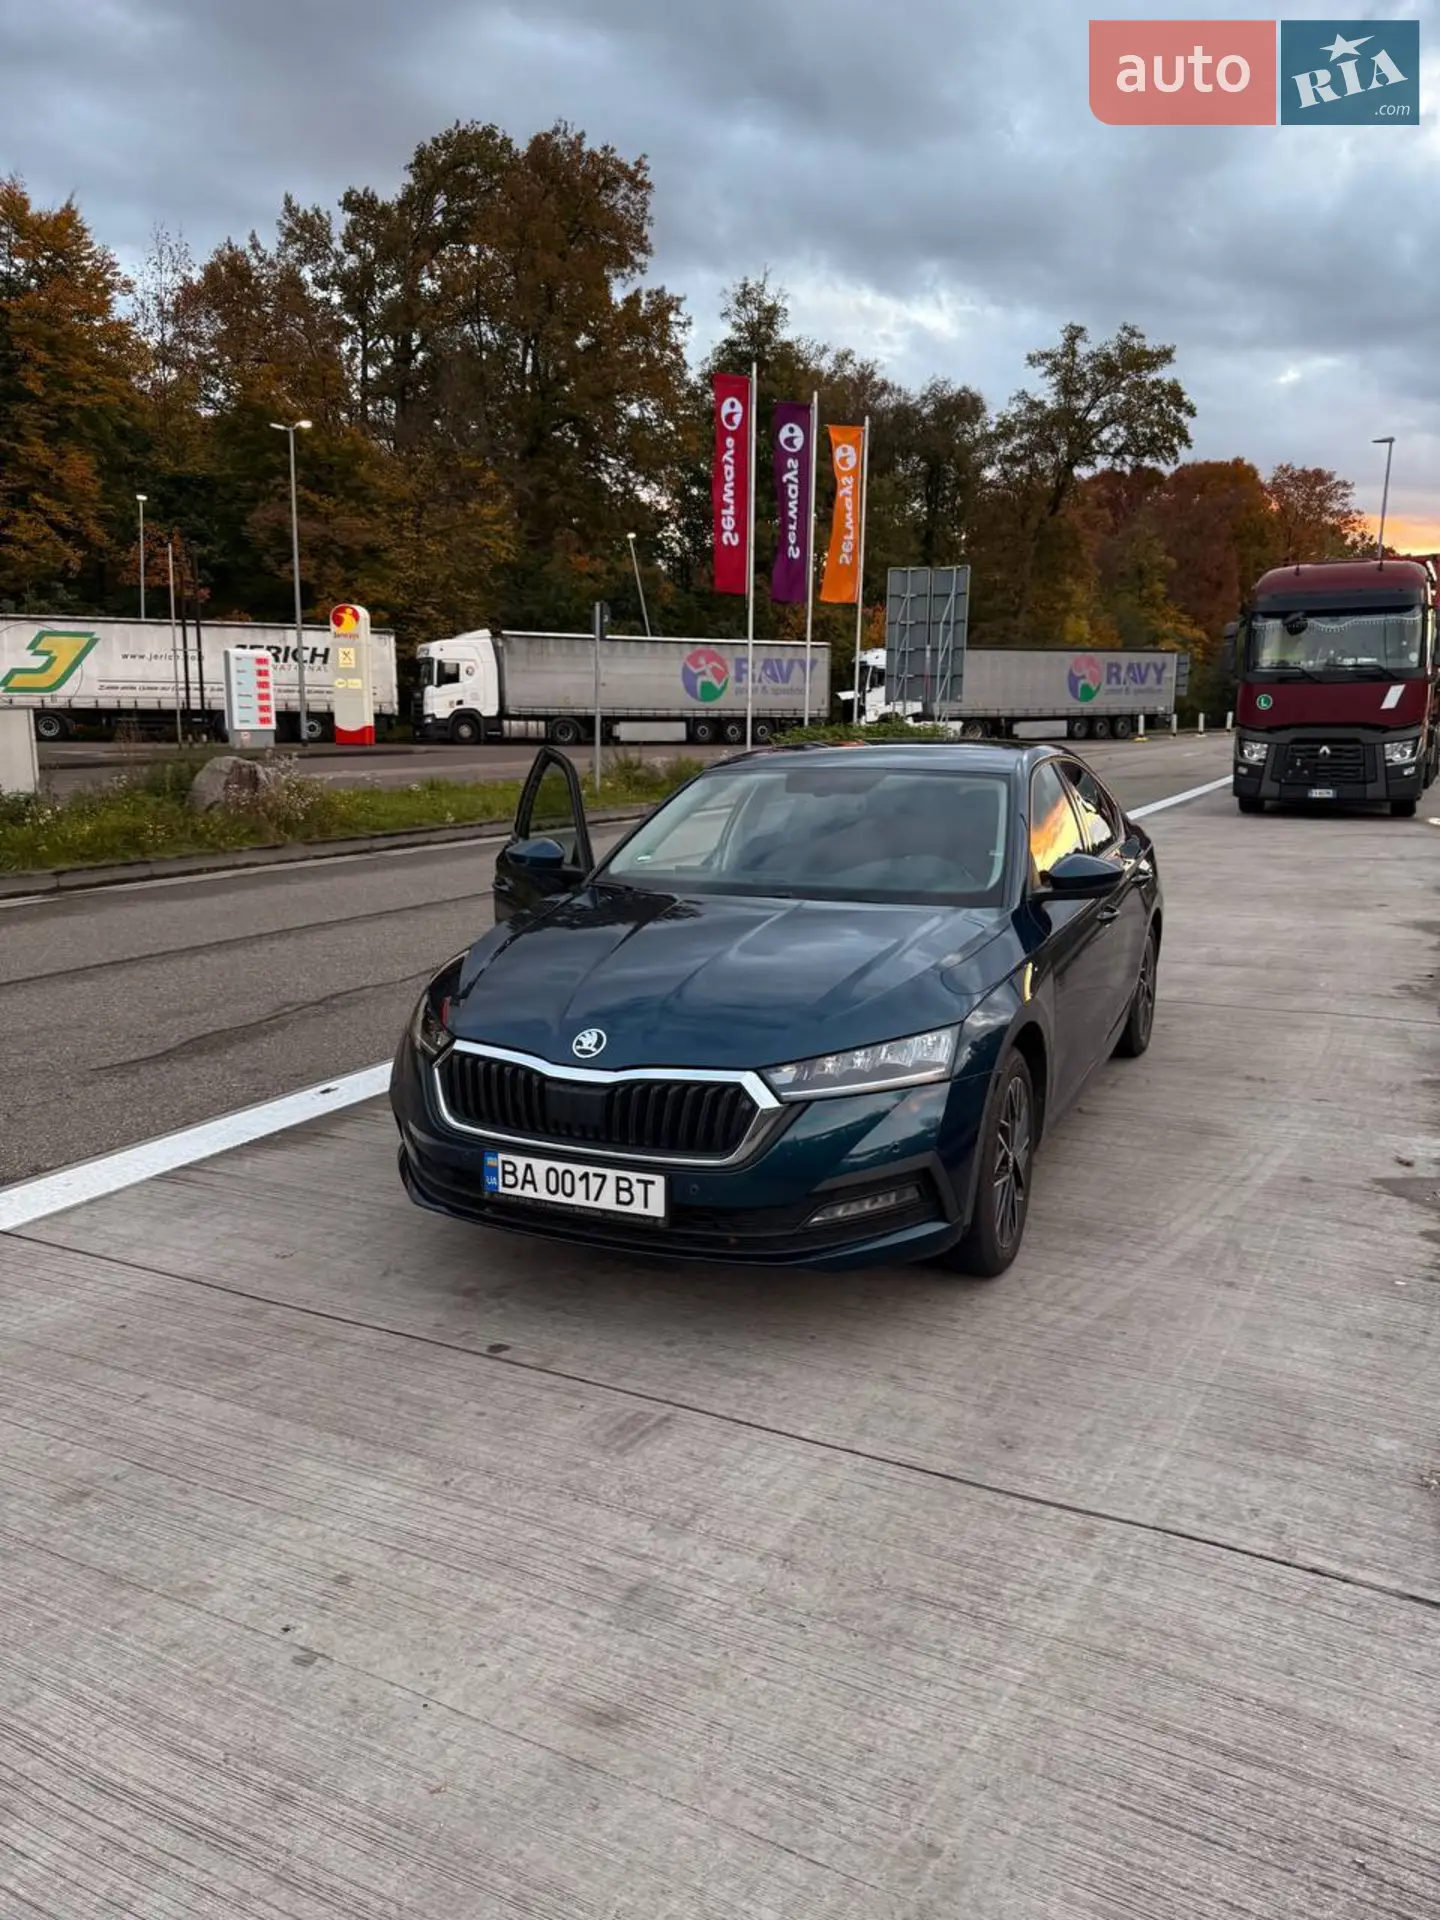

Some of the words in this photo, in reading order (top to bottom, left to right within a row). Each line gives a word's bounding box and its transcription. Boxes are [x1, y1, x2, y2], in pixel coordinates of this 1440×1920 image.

[120, 652, 204, 662] www.jeric.o
[734, 657, 818, 684] RAVY
[1106, 661, 1167, 685] RAVY
[485, 1175, 497, 1187] UA
[501, 1160, 538, 1193] BA
[545, 1167, 607, 1202] 0017
[615, 1176, 656, 1210] BT
